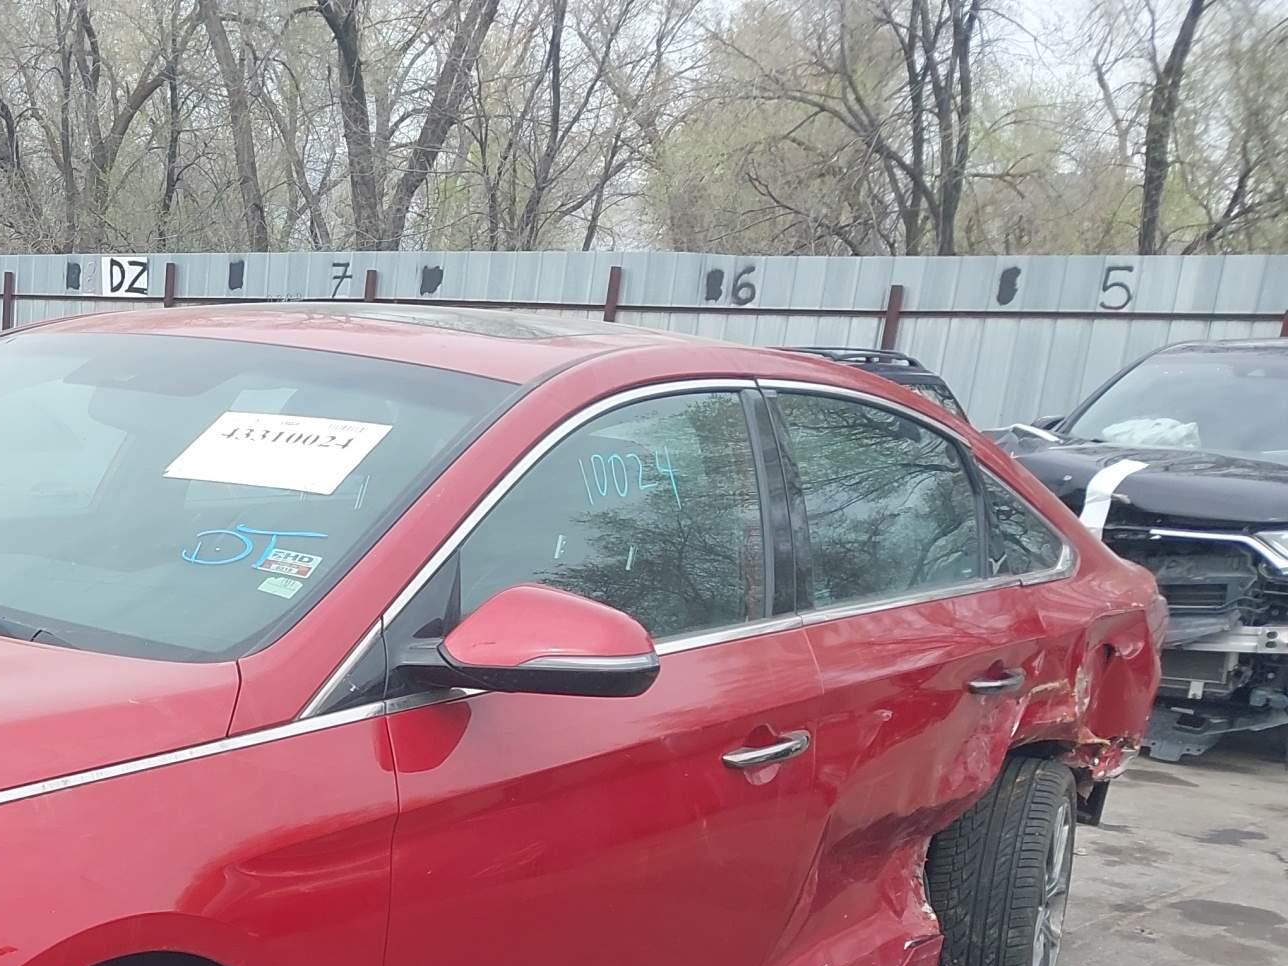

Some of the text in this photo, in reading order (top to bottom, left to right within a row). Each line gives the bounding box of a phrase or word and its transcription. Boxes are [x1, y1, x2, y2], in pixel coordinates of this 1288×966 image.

[332, 262, 353, 298] 7
[731, 265, 756, 304] 6
[1100, 265, 1133, 310] 5
[221, 427, 355, 450] 43310024
[579, 446, 682, 509] 10024
